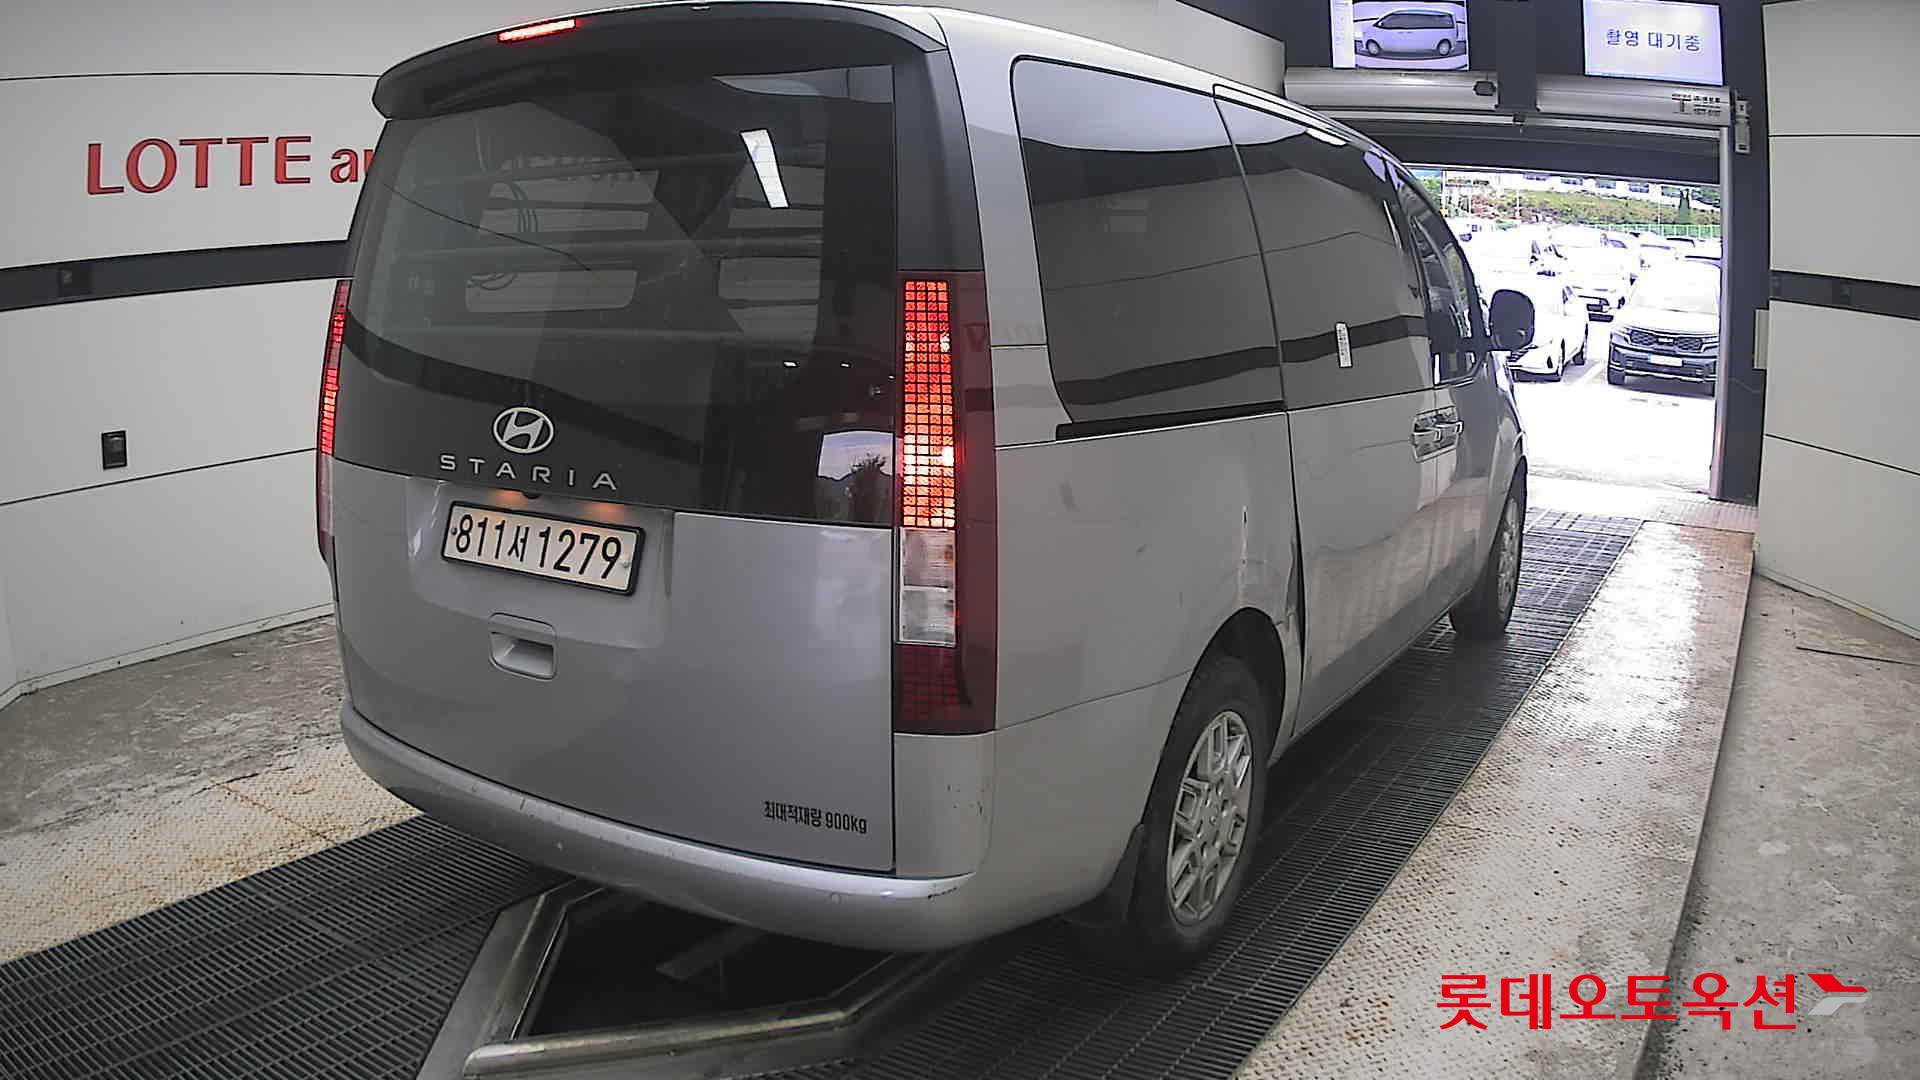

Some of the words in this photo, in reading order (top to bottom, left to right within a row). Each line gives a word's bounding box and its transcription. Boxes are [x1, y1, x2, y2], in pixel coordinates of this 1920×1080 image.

[1647, 31, 1701, 52] 대기중
[87, 136, 311, 195] LOTTE
[440, 455, 617, 490] STARIA
[455, 514, 622, 579] 811서1279
[763, 801, 822, 828] 최대적재량
